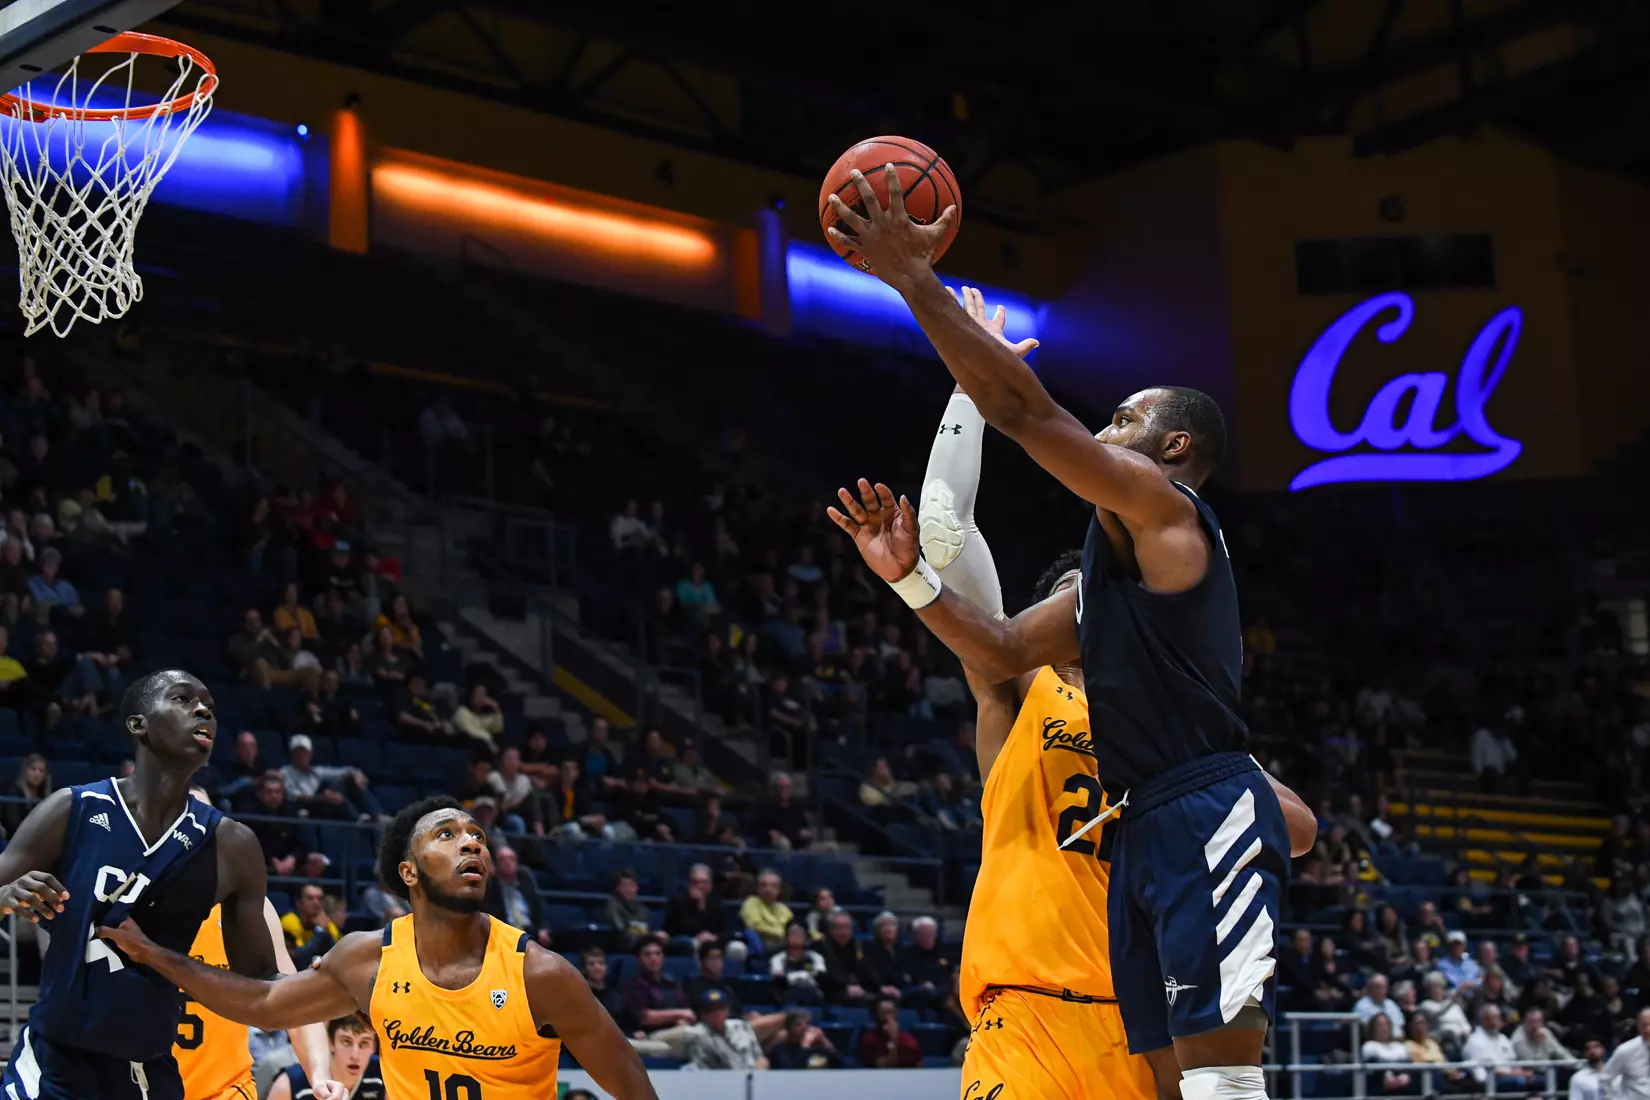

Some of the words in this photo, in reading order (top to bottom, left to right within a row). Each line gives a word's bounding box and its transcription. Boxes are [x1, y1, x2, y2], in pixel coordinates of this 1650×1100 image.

[1289, 291, 1524, 491] Cal
[383, 1019, 450, 1050] Golden
[452, 1030, 518, 1060] Bears
